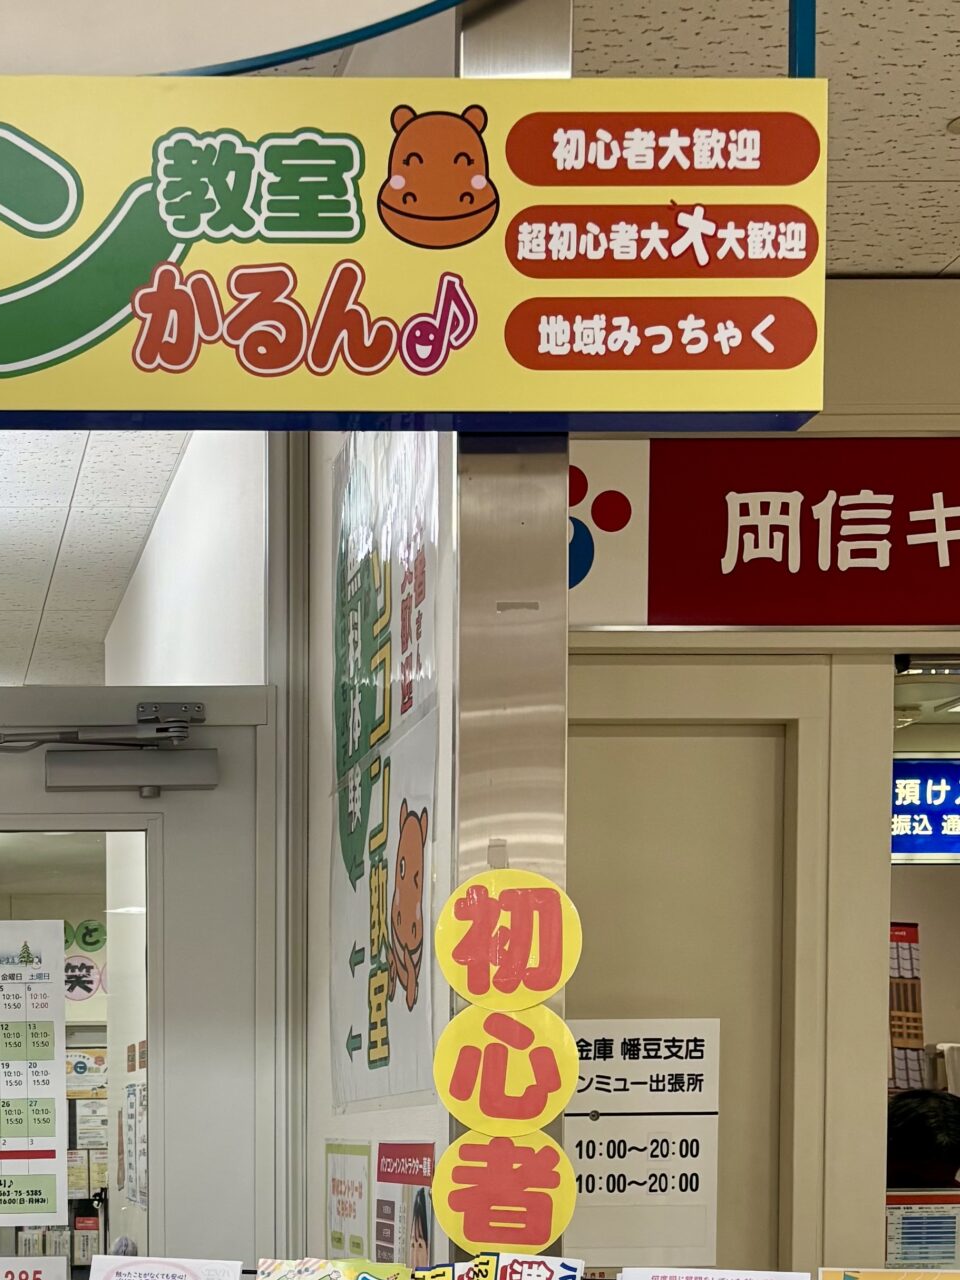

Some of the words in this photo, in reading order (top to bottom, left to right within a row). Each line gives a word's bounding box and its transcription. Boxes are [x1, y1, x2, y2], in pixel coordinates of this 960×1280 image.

[552, 127, 762, 171] 初心者大歓迎
[155, 127, 366, 243] 教室
[516, 205, 808, 267] 超初心者大大大歓迎
[537, 314, 777, 357] 地域みっちゃく
[367, 540, 393, 1072] ソコン教室
[895, 778, 960, 806] 預け
[891, 813, 932, 836] 振込
[1, 973, 23, 981] 金曜日
[28, 972, 50, 981] 土曜日
[447, 884, 563, 1246] 初心者
[577, 1037, 614, 1061] 金庫
[620, 1037, 705, 1061] 幡豆支店
